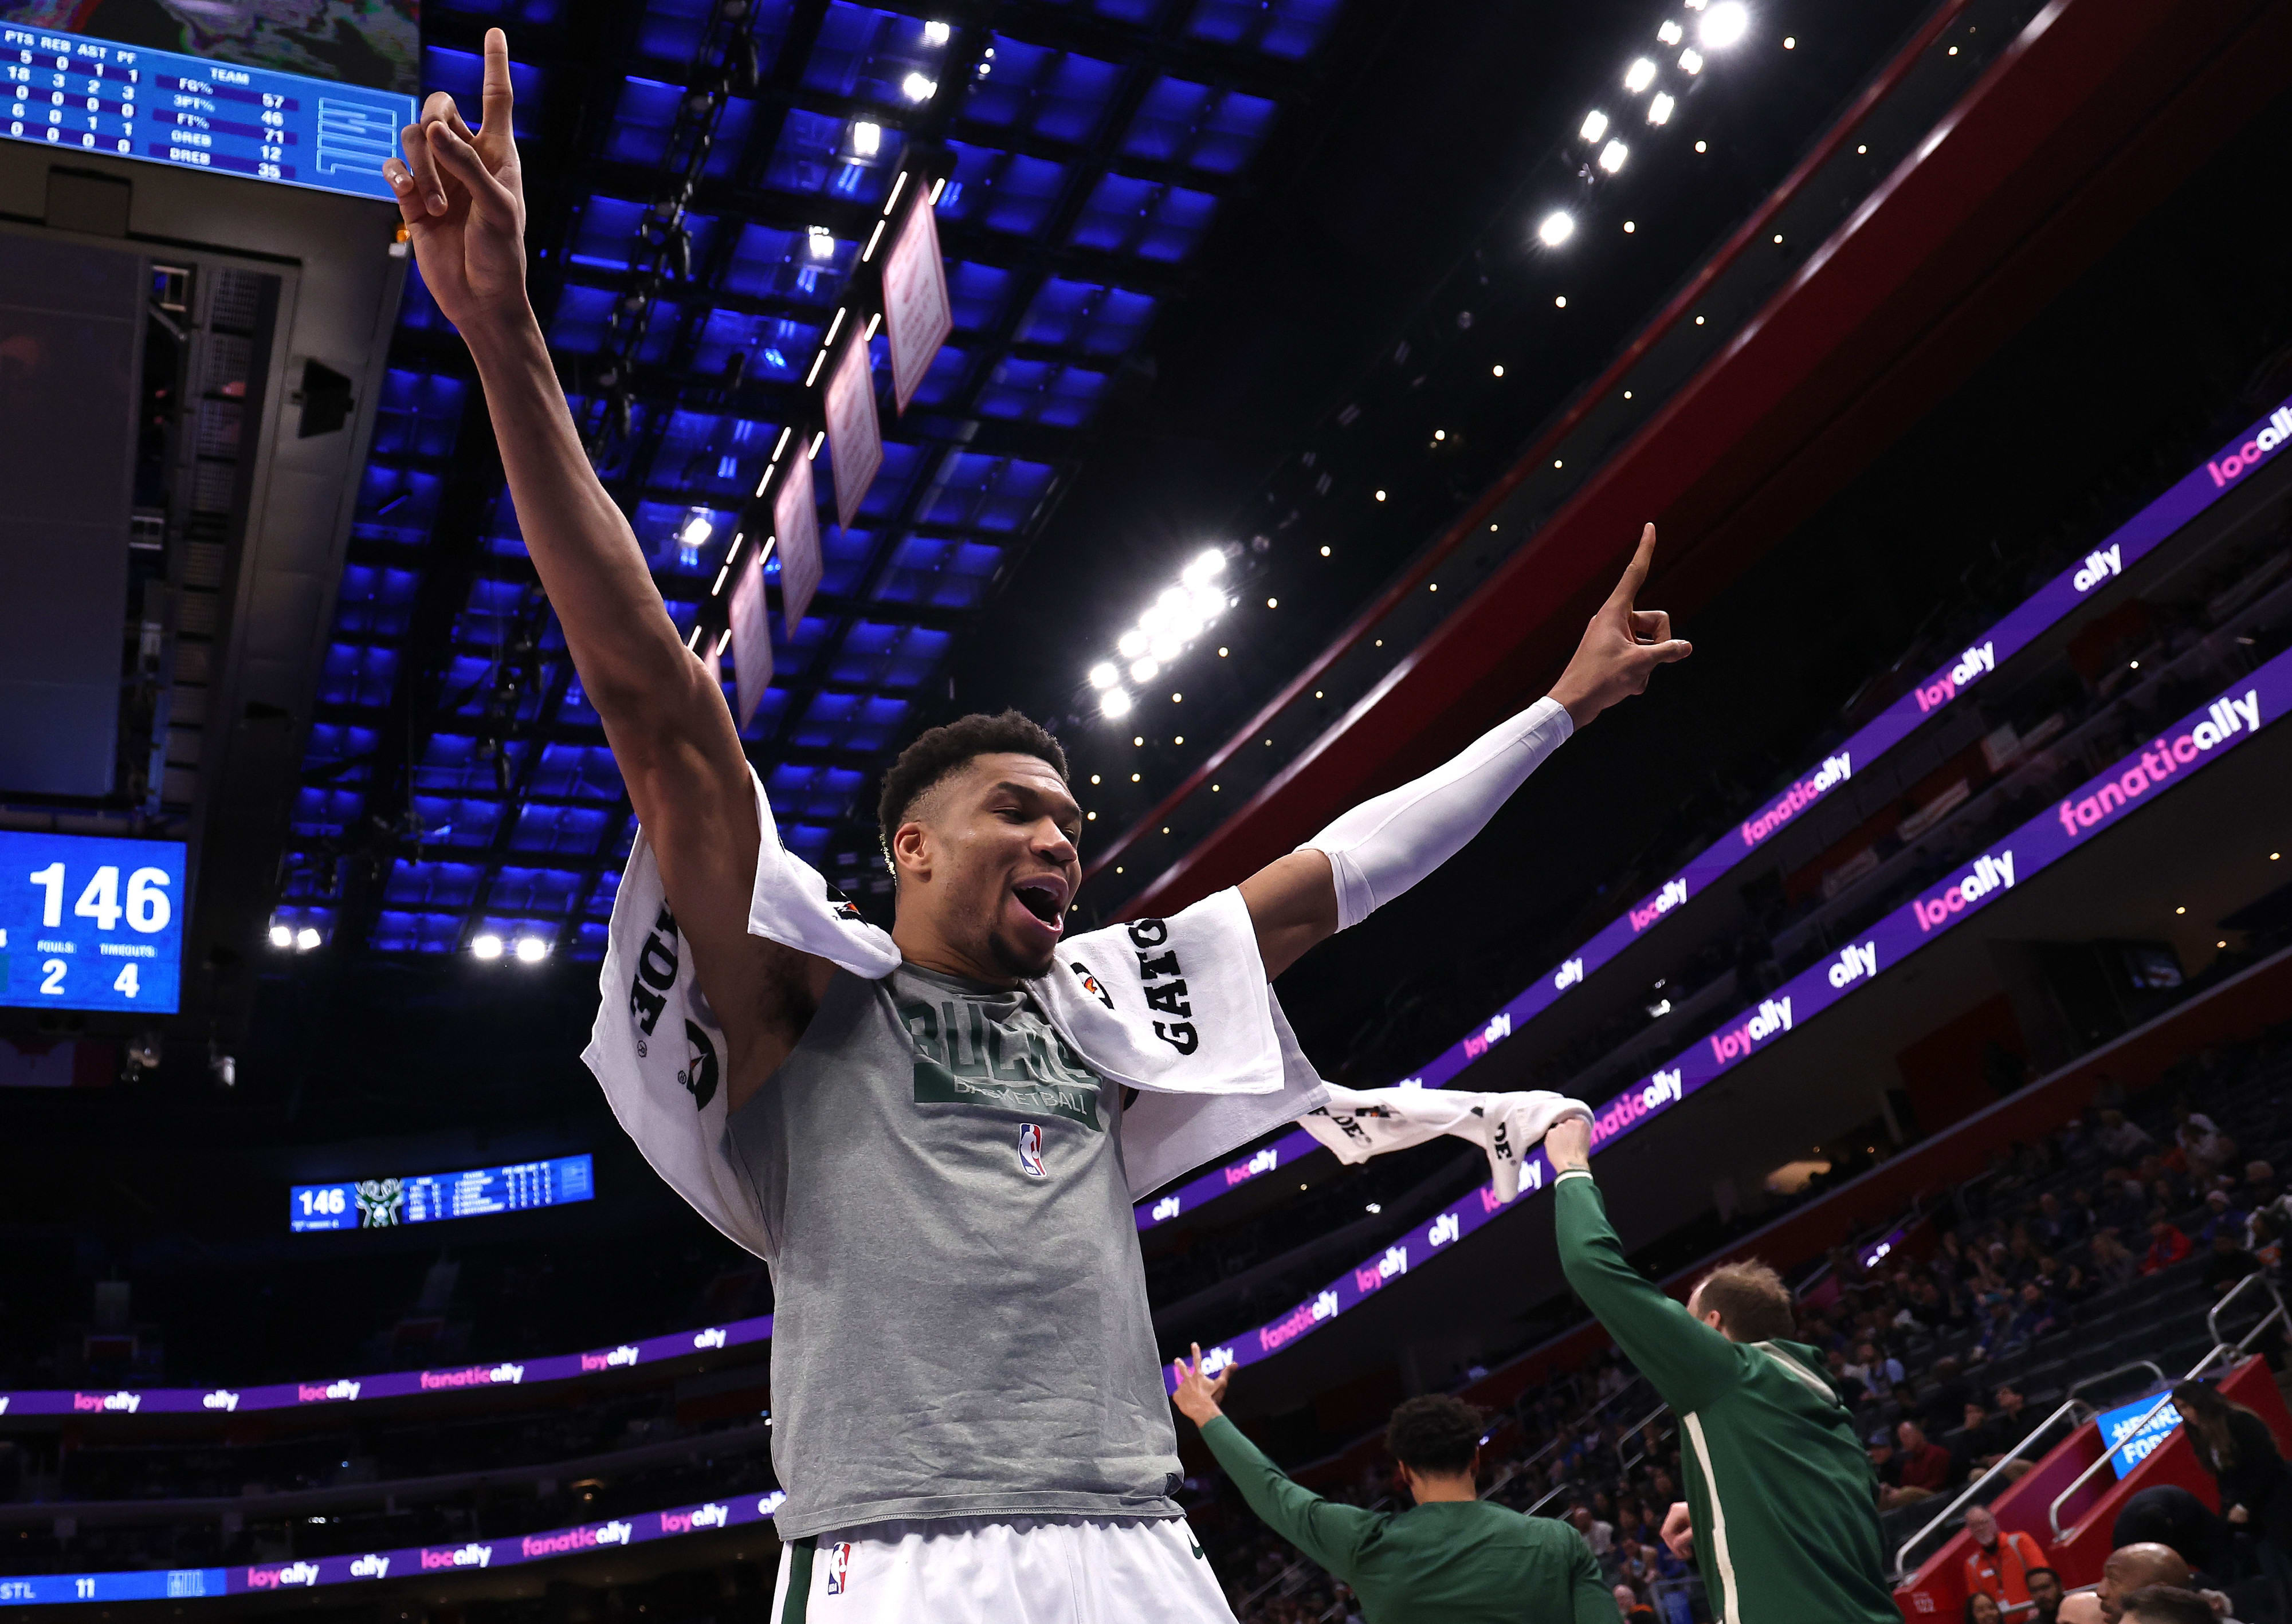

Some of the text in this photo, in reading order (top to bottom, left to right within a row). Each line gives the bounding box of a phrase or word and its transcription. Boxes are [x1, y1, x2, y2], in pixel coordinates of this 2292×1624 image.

[5, 30, 135, 64] PTS REB AST PF
[8, 66, 134, 100] 18 3 2 3
[21, 50, 138, 83] 5 0 1 1
[210, 68, 249, 84] TEAM
[17, 85, 134, 117] 0 0 0 0
[179, 77, 283, 108] FG% 57
[13, 104, 132, 136] 6 0 1 1
[174, 95, 283, 126] 3PT% 46
[11, 121, 130, 154] 0 0 0 0
[177, 113, 284, 143] FT% 71
[171, 131, 281, 161] OREB 12
[170, 148, 281, 179] DREB 35
[2207, 407, 2292, 487] locall
[2074, 544, 2121, 592] ally
[1915, 642, 1994, 712] loyally
[2059, 689, 2259, 836] fanatically
[1742, 752, 1851, 846] fanatically
[30, 863, 170, 933] 146
[1630, 878, 1686, 931] locally
[1913, 850, 2014, 931] locally
[38, 941, 73, 953] FOULS
[40, 959, 139, 997] 2 4
[1555, 958, 1583, 990] ally
[1828, 942, 1876, 988] ally
[1126, 918, 1198, 1055] GATO
[1463, 1013, 1510, 1059] loyally
[1711, 996, 1792, 1064] loyally
[1591, 1068, 1682, 1145] natically
[1225, 1149, 1277, 1185] locally
[299, 1189, 345, 1215] 146
[1481, 1159, 1541, 1213] lolly
[1152, 1197, 1179, 1221] ally
[1428, 1213, 1459, 1246] ally
[1355, 1246, 1407, 1292] loyally
[1259, 1291, 1337, 1351] fanatically
[694, 1328, 726, 1348] ally
[582, 1346, 638, 1370] loyally
[299, 1379, 360, 1401] locally
[421, 1363, 524, 1389] fanatically
[74, 1391, 140, 1413] loyally
[203, 1390, 238, 1411] ally
[2122, 1430, 2172, 1464] FOR
[661, 1503, 728, 1532] loyally
[758, 1491, 786, 1514] all
[421, 1543, 492, 1568] locally
[522, 1521, 632, 1557] fanatically
[248, 1562, 319, 1588] loyally
[350, 1554, 390, 1578] ally
[0, 1578, 95, 1599] STL 11
